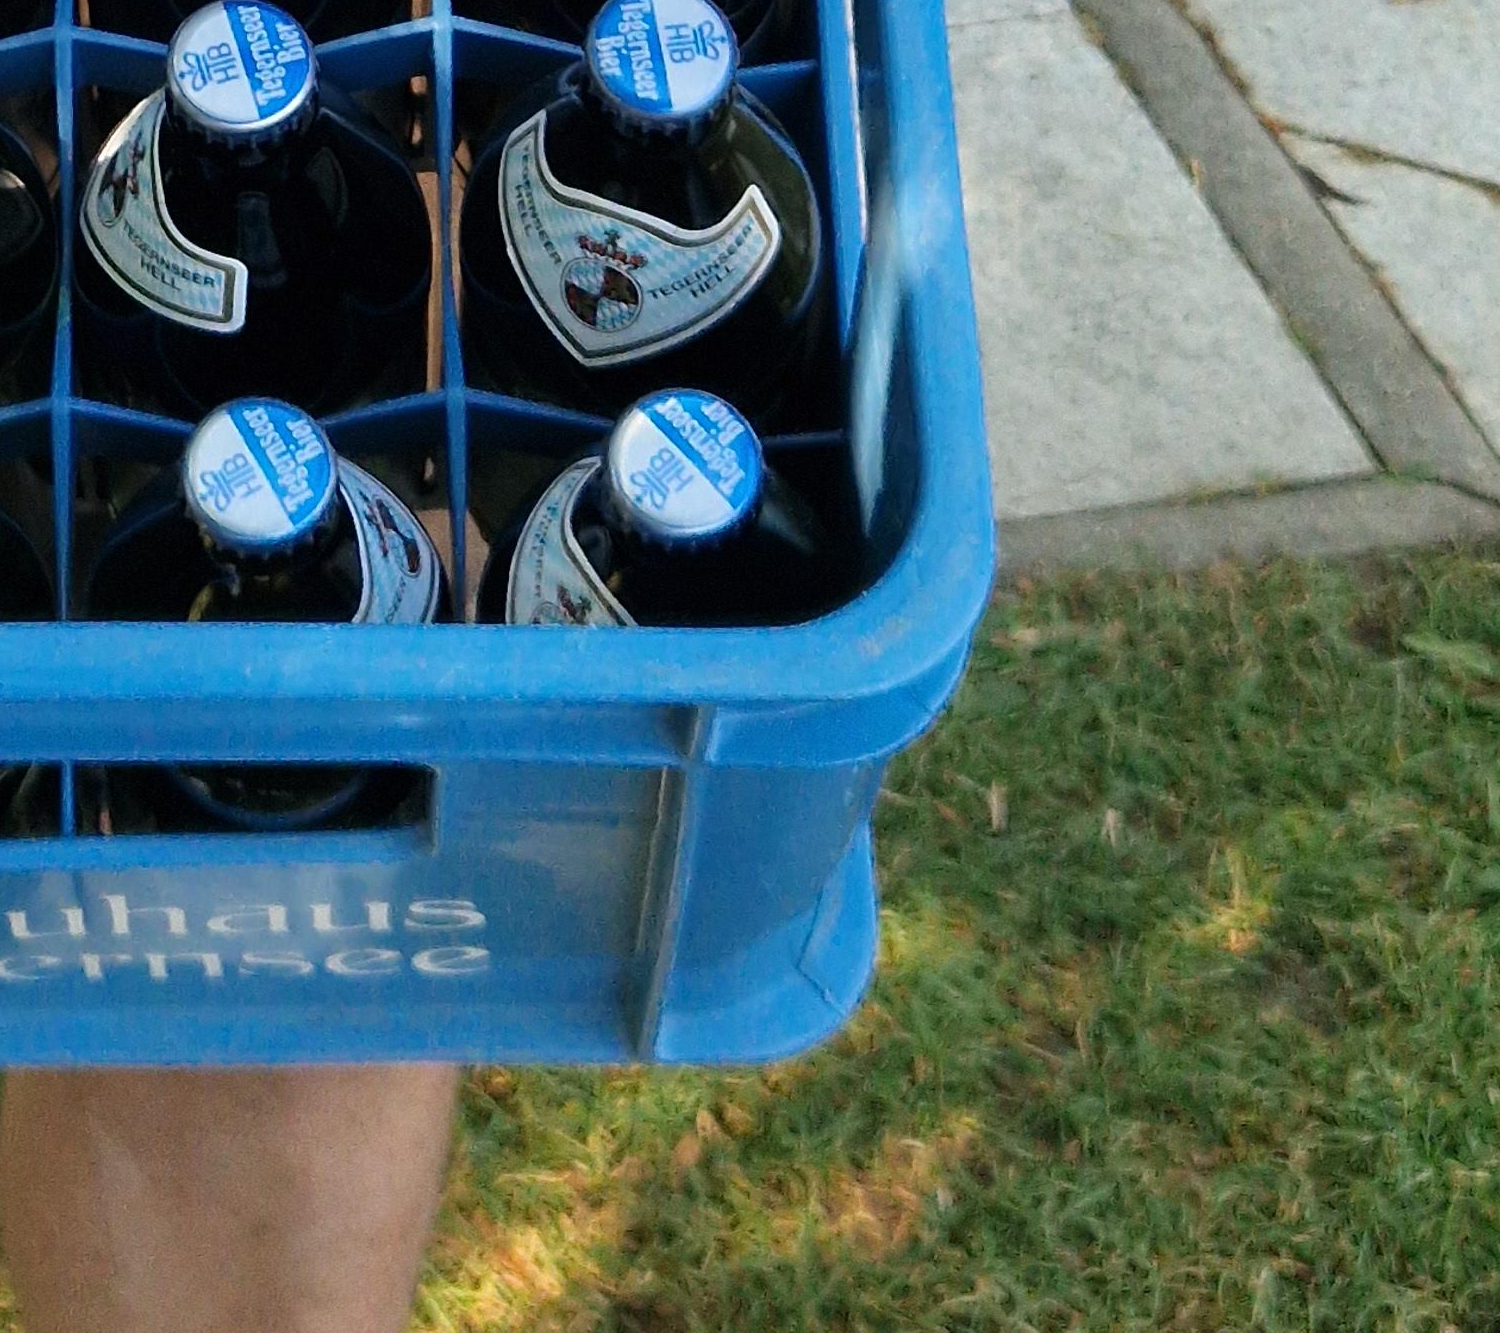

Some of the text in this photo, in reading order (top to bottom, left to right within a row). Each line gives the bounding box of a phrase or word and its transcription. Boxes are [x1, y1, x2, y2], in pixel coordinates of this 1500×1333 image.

[237, 5, 287, 107] Tegernseer
[273, 22, 306, 65] Bier
[595, 34, 628, 77] Bier
[141, 255, 181, 292] HELL
[653, 396, 746, 496] Tegernseer
[700, 400, 746, 447] Bier
[243, 406, 315, 513] Tegernseer
